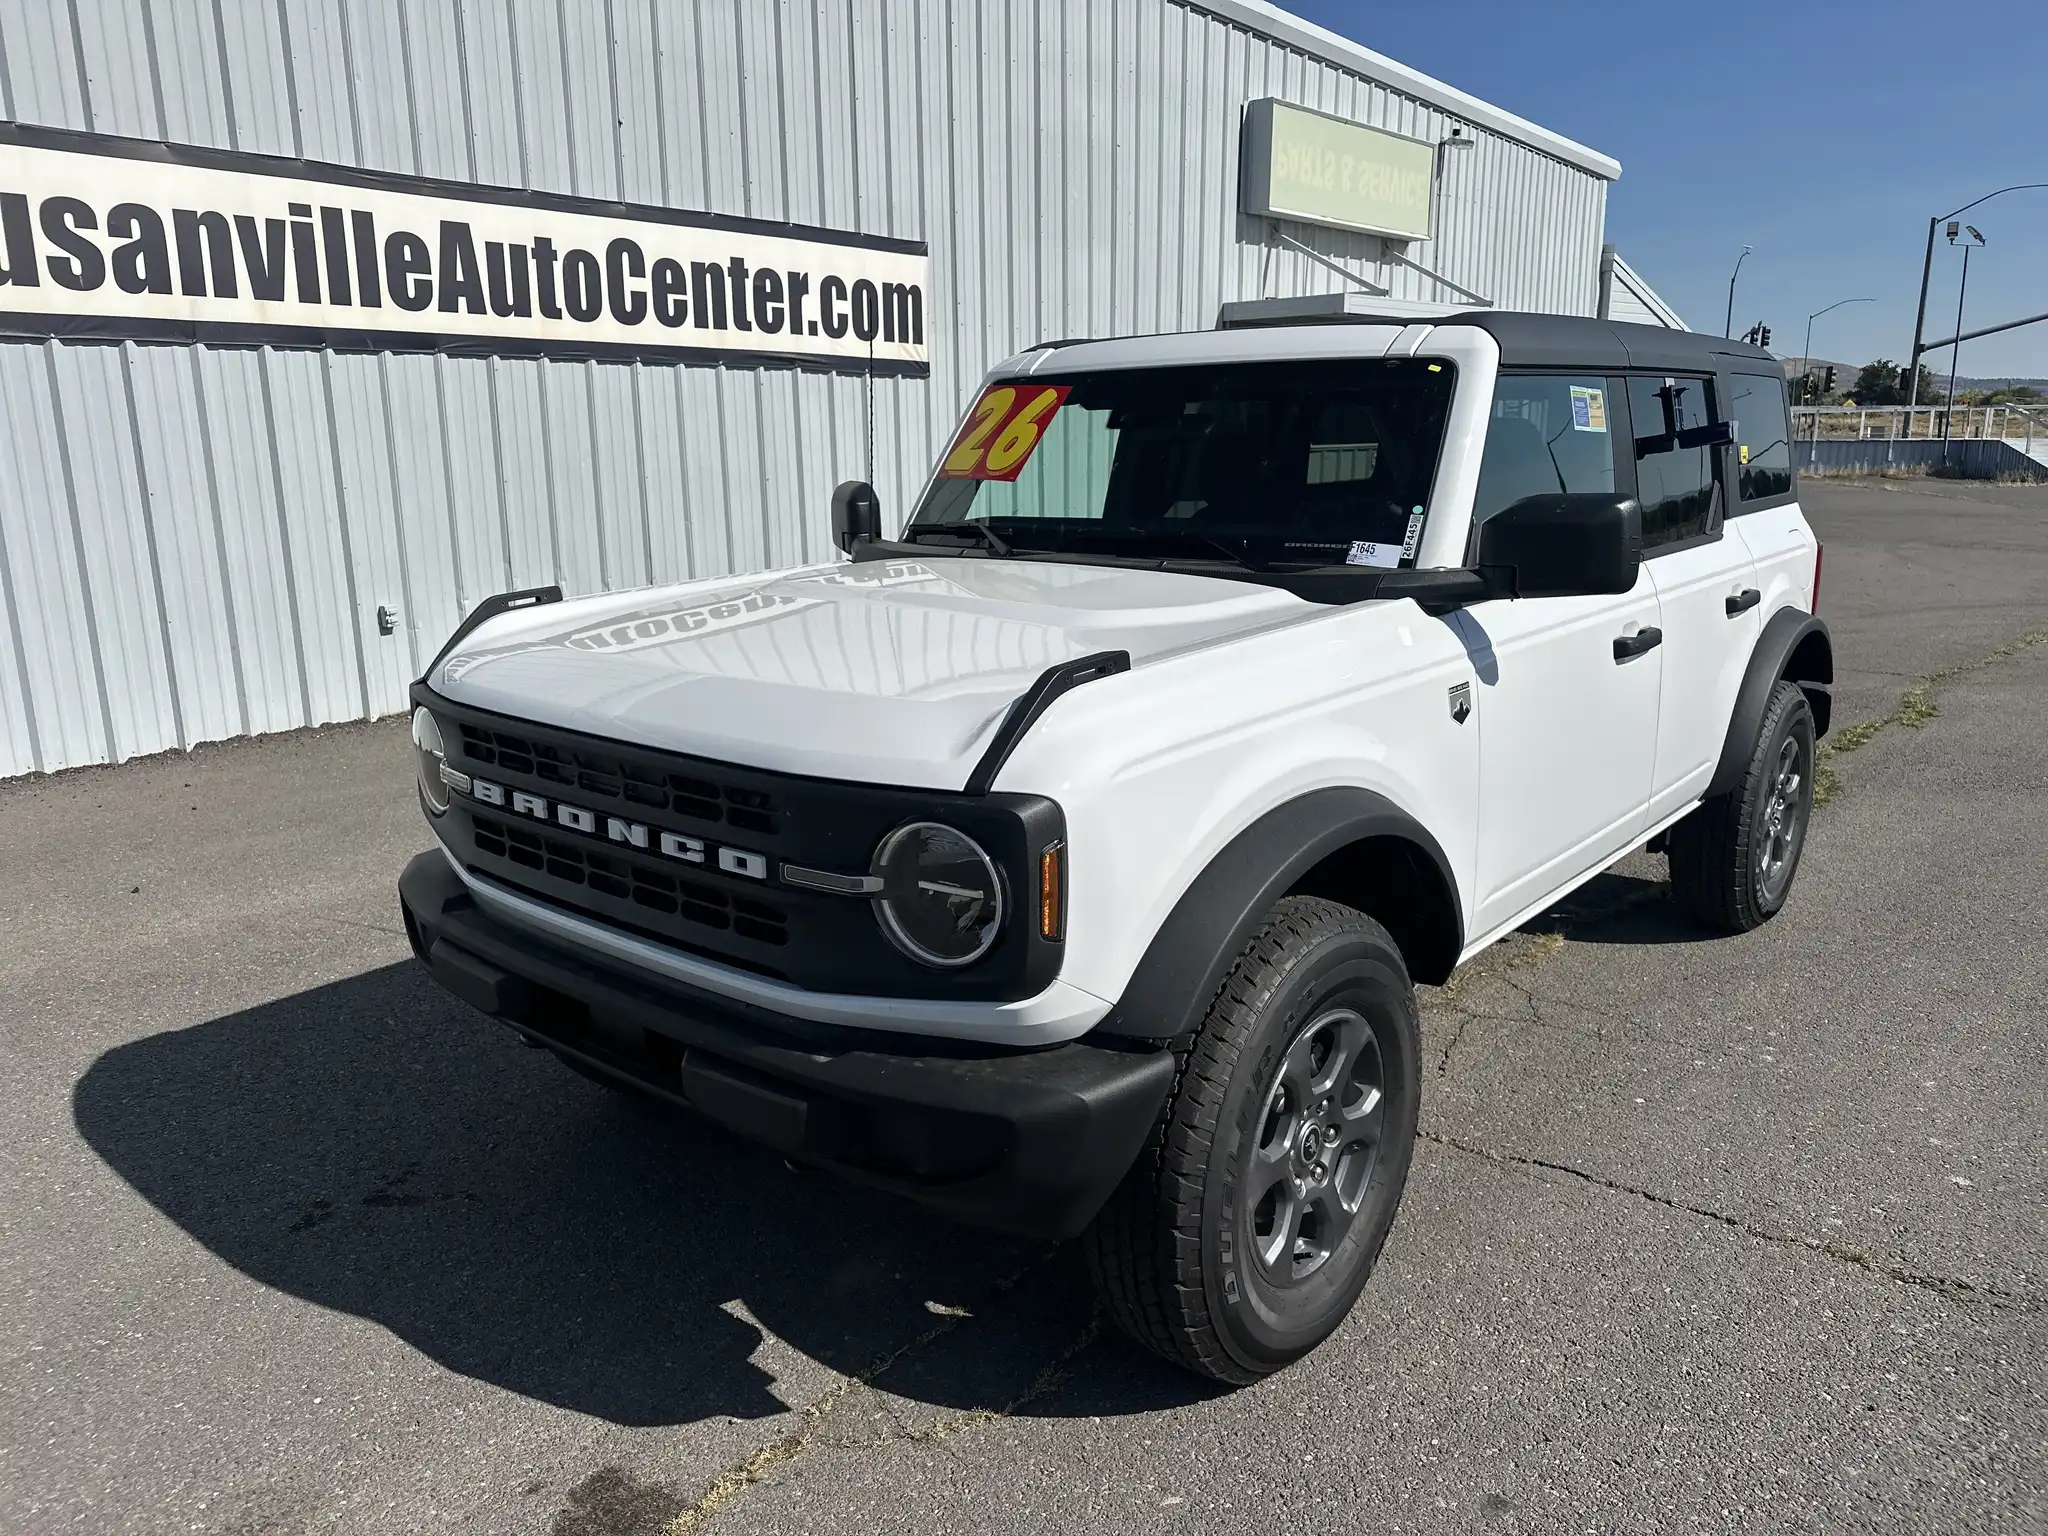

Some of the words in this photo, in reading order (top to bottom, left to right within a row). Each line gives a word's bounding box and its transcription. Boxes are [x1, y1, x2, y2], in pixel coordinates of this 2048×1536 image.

[945, 388, 1057, 475] 26
[1402, 523, 1418, 558] 26F445
[473, 779, 767, 879] BRONCO
